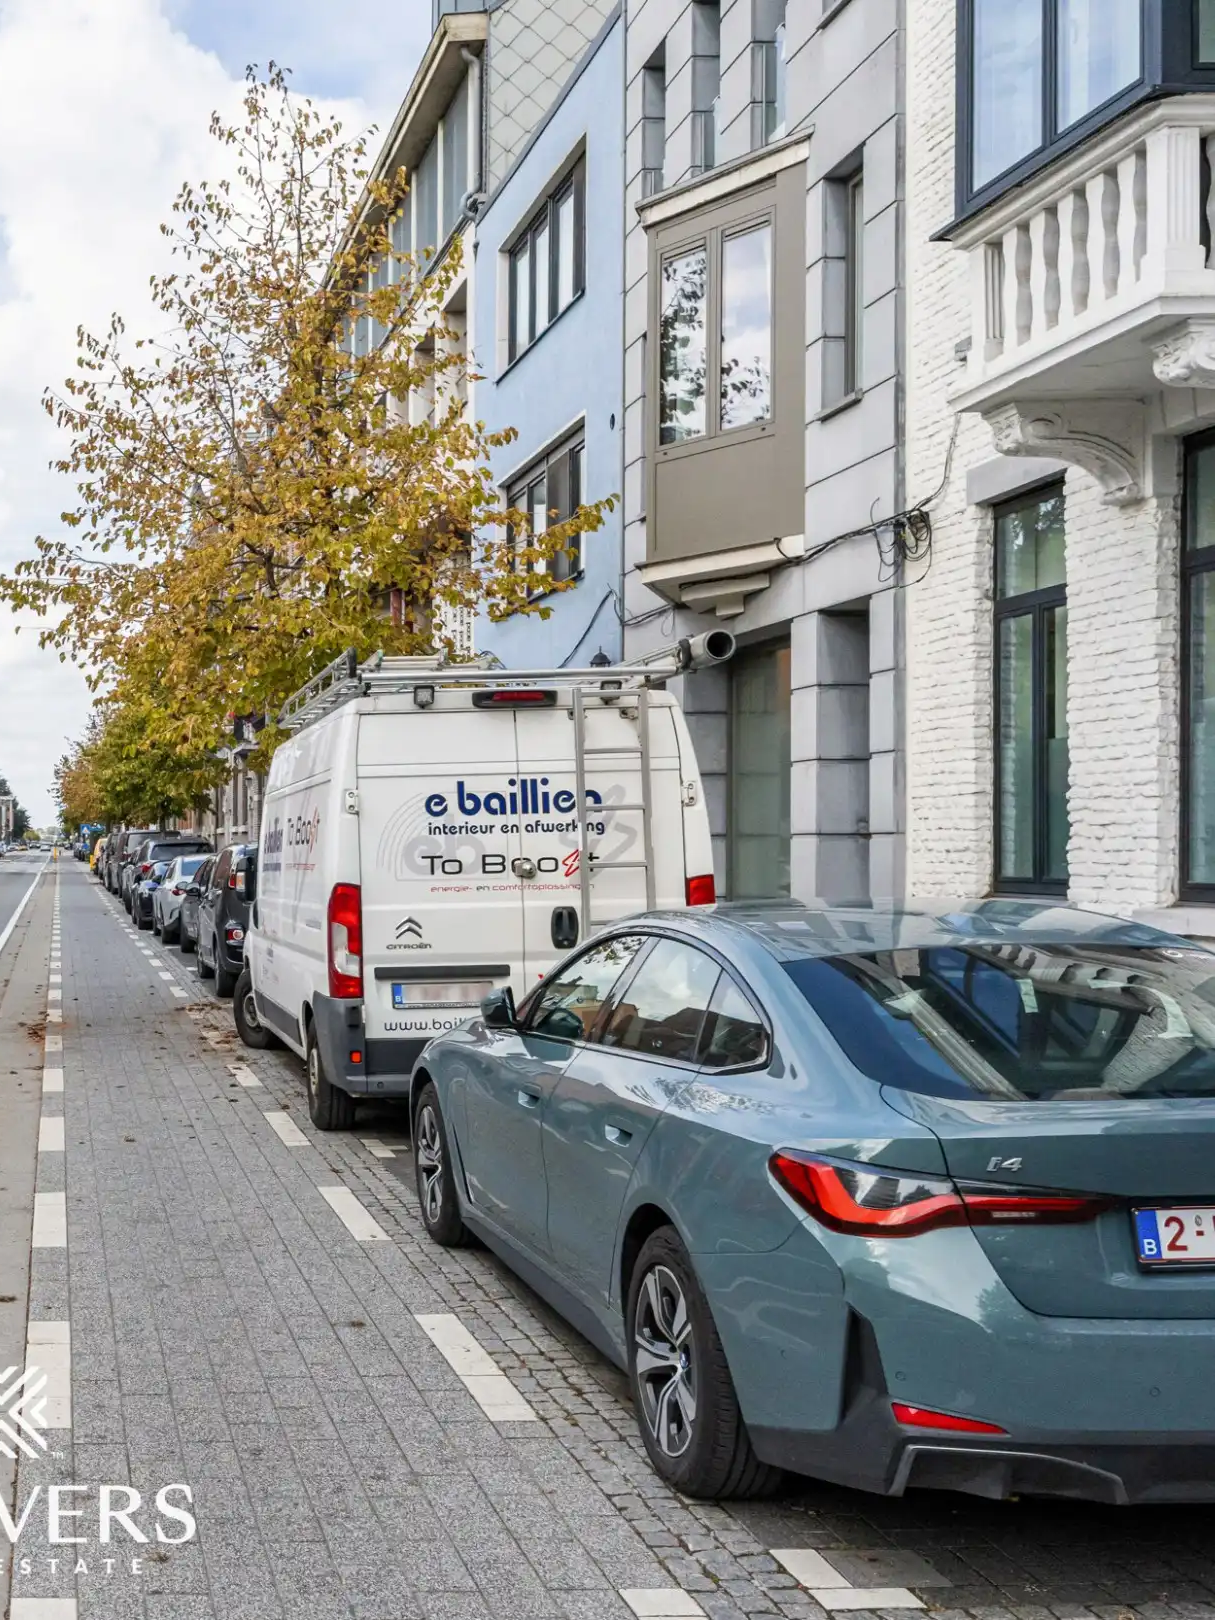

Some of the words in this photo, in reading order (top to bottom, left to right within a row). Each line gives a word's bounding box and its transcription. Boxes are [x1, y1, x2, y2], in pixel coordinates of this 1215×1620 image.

[425, 793, 448, 817] e
[457, 777, 603, 817] baillien
[428, 821, 495, 836] interieur
[500, 823, 519, 834] en
[525, 819, 605, 836] afwerkng
[421, 855, 463, 875] To
[492, 882, 595, 894] comfortoplossingn
[384, 1017, 467, 1031] www.bai
[986, 1156, 1023, 1172] i4
[1143, 1238, 1157, 1255] B
